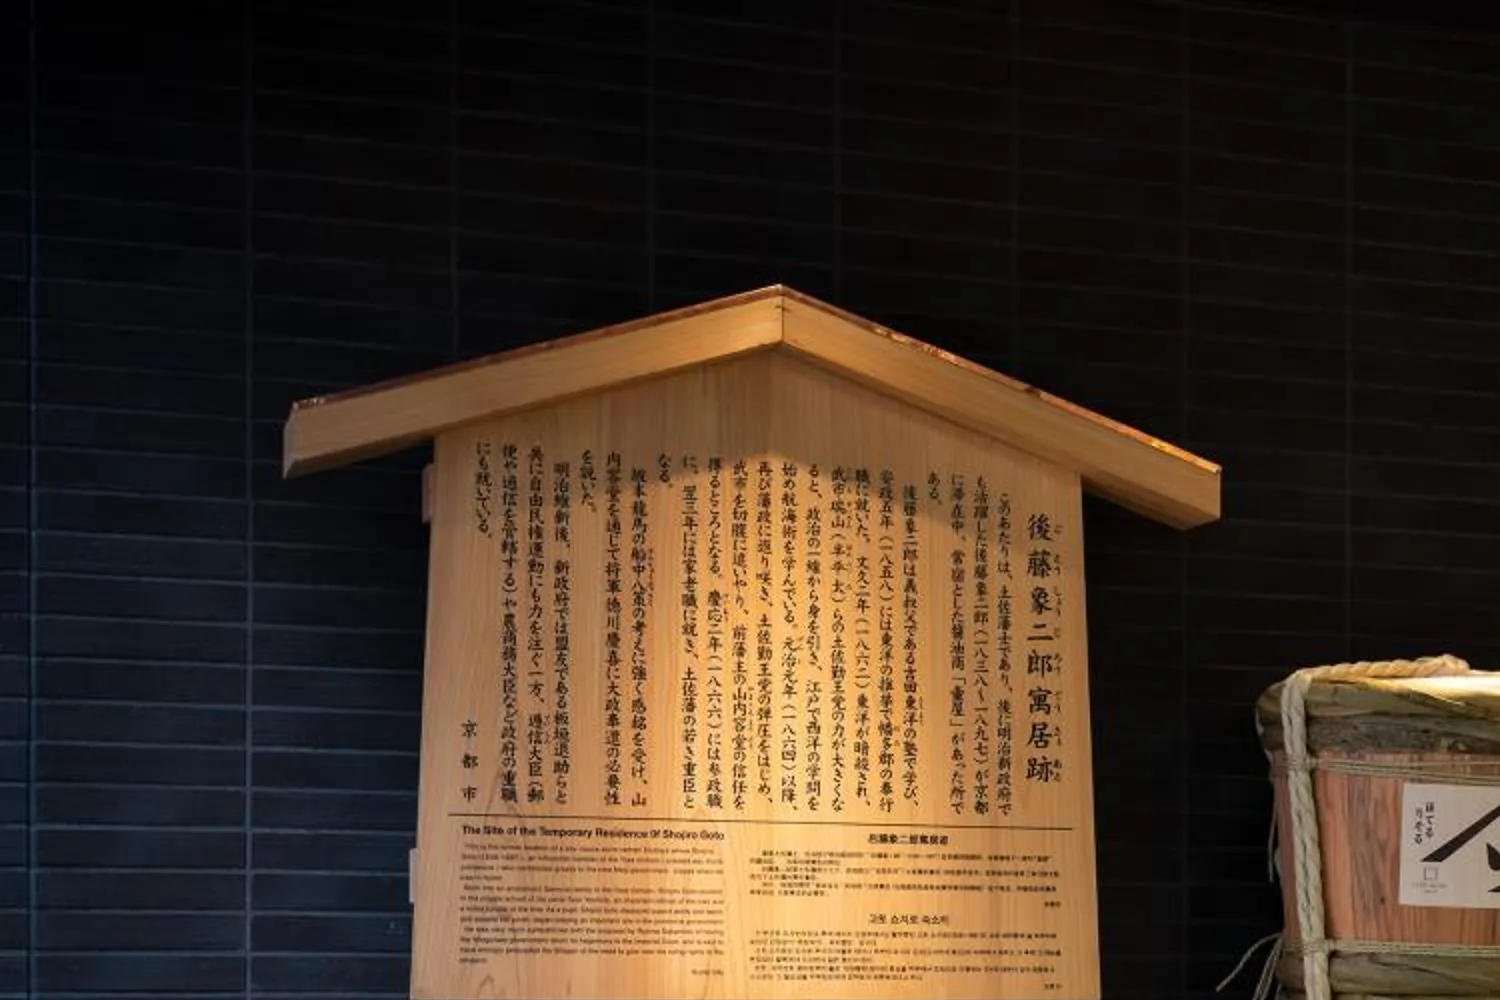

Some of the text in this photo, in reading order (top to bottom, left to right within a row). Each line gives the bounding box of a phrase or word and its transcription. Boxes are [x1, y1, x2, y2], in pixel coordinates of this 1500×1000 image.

[657, 453, 673, 488] なる。
[1025, 512, 1055, 784] 後藤象二郎寓居跡
[461, 719, 479, 802] 京都市
[463, 825, 481, 835] The
[506, 826, 517, 836] of
[519, 827, 537, 836] the
[539, 826, 593, 839] Temporary
